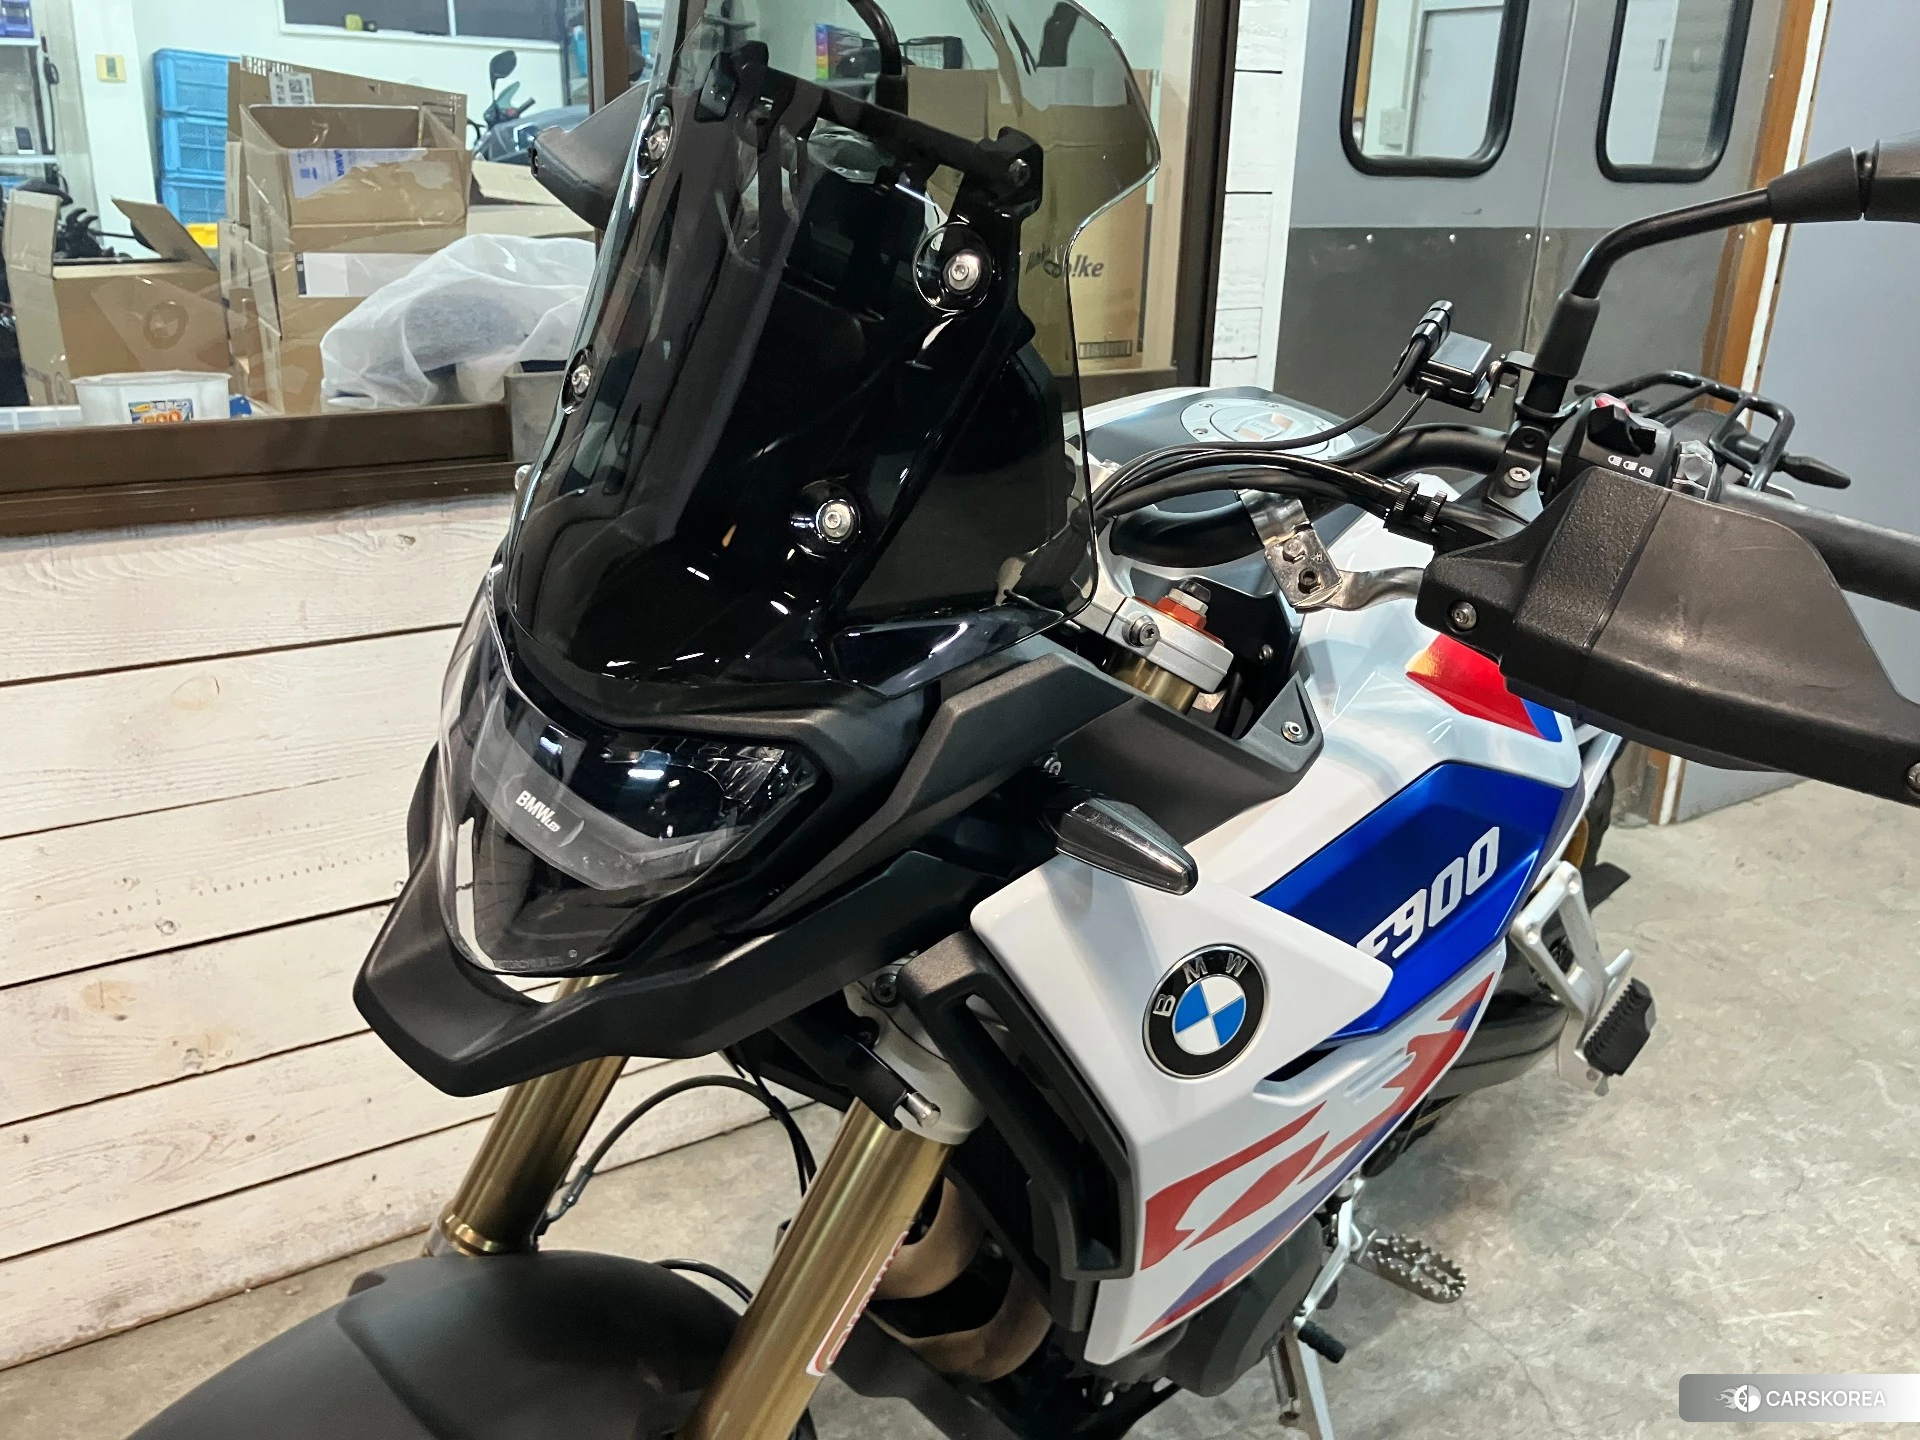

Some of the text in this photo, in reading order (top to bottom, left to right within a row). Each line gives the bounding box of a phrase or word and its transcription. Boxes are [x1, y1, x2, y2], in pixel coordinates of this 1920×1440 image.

[515, 789, 556, 824] BMW
[1356, 826, 1500, 959] F900
[1152, 952, 1249, 1017] BMW
